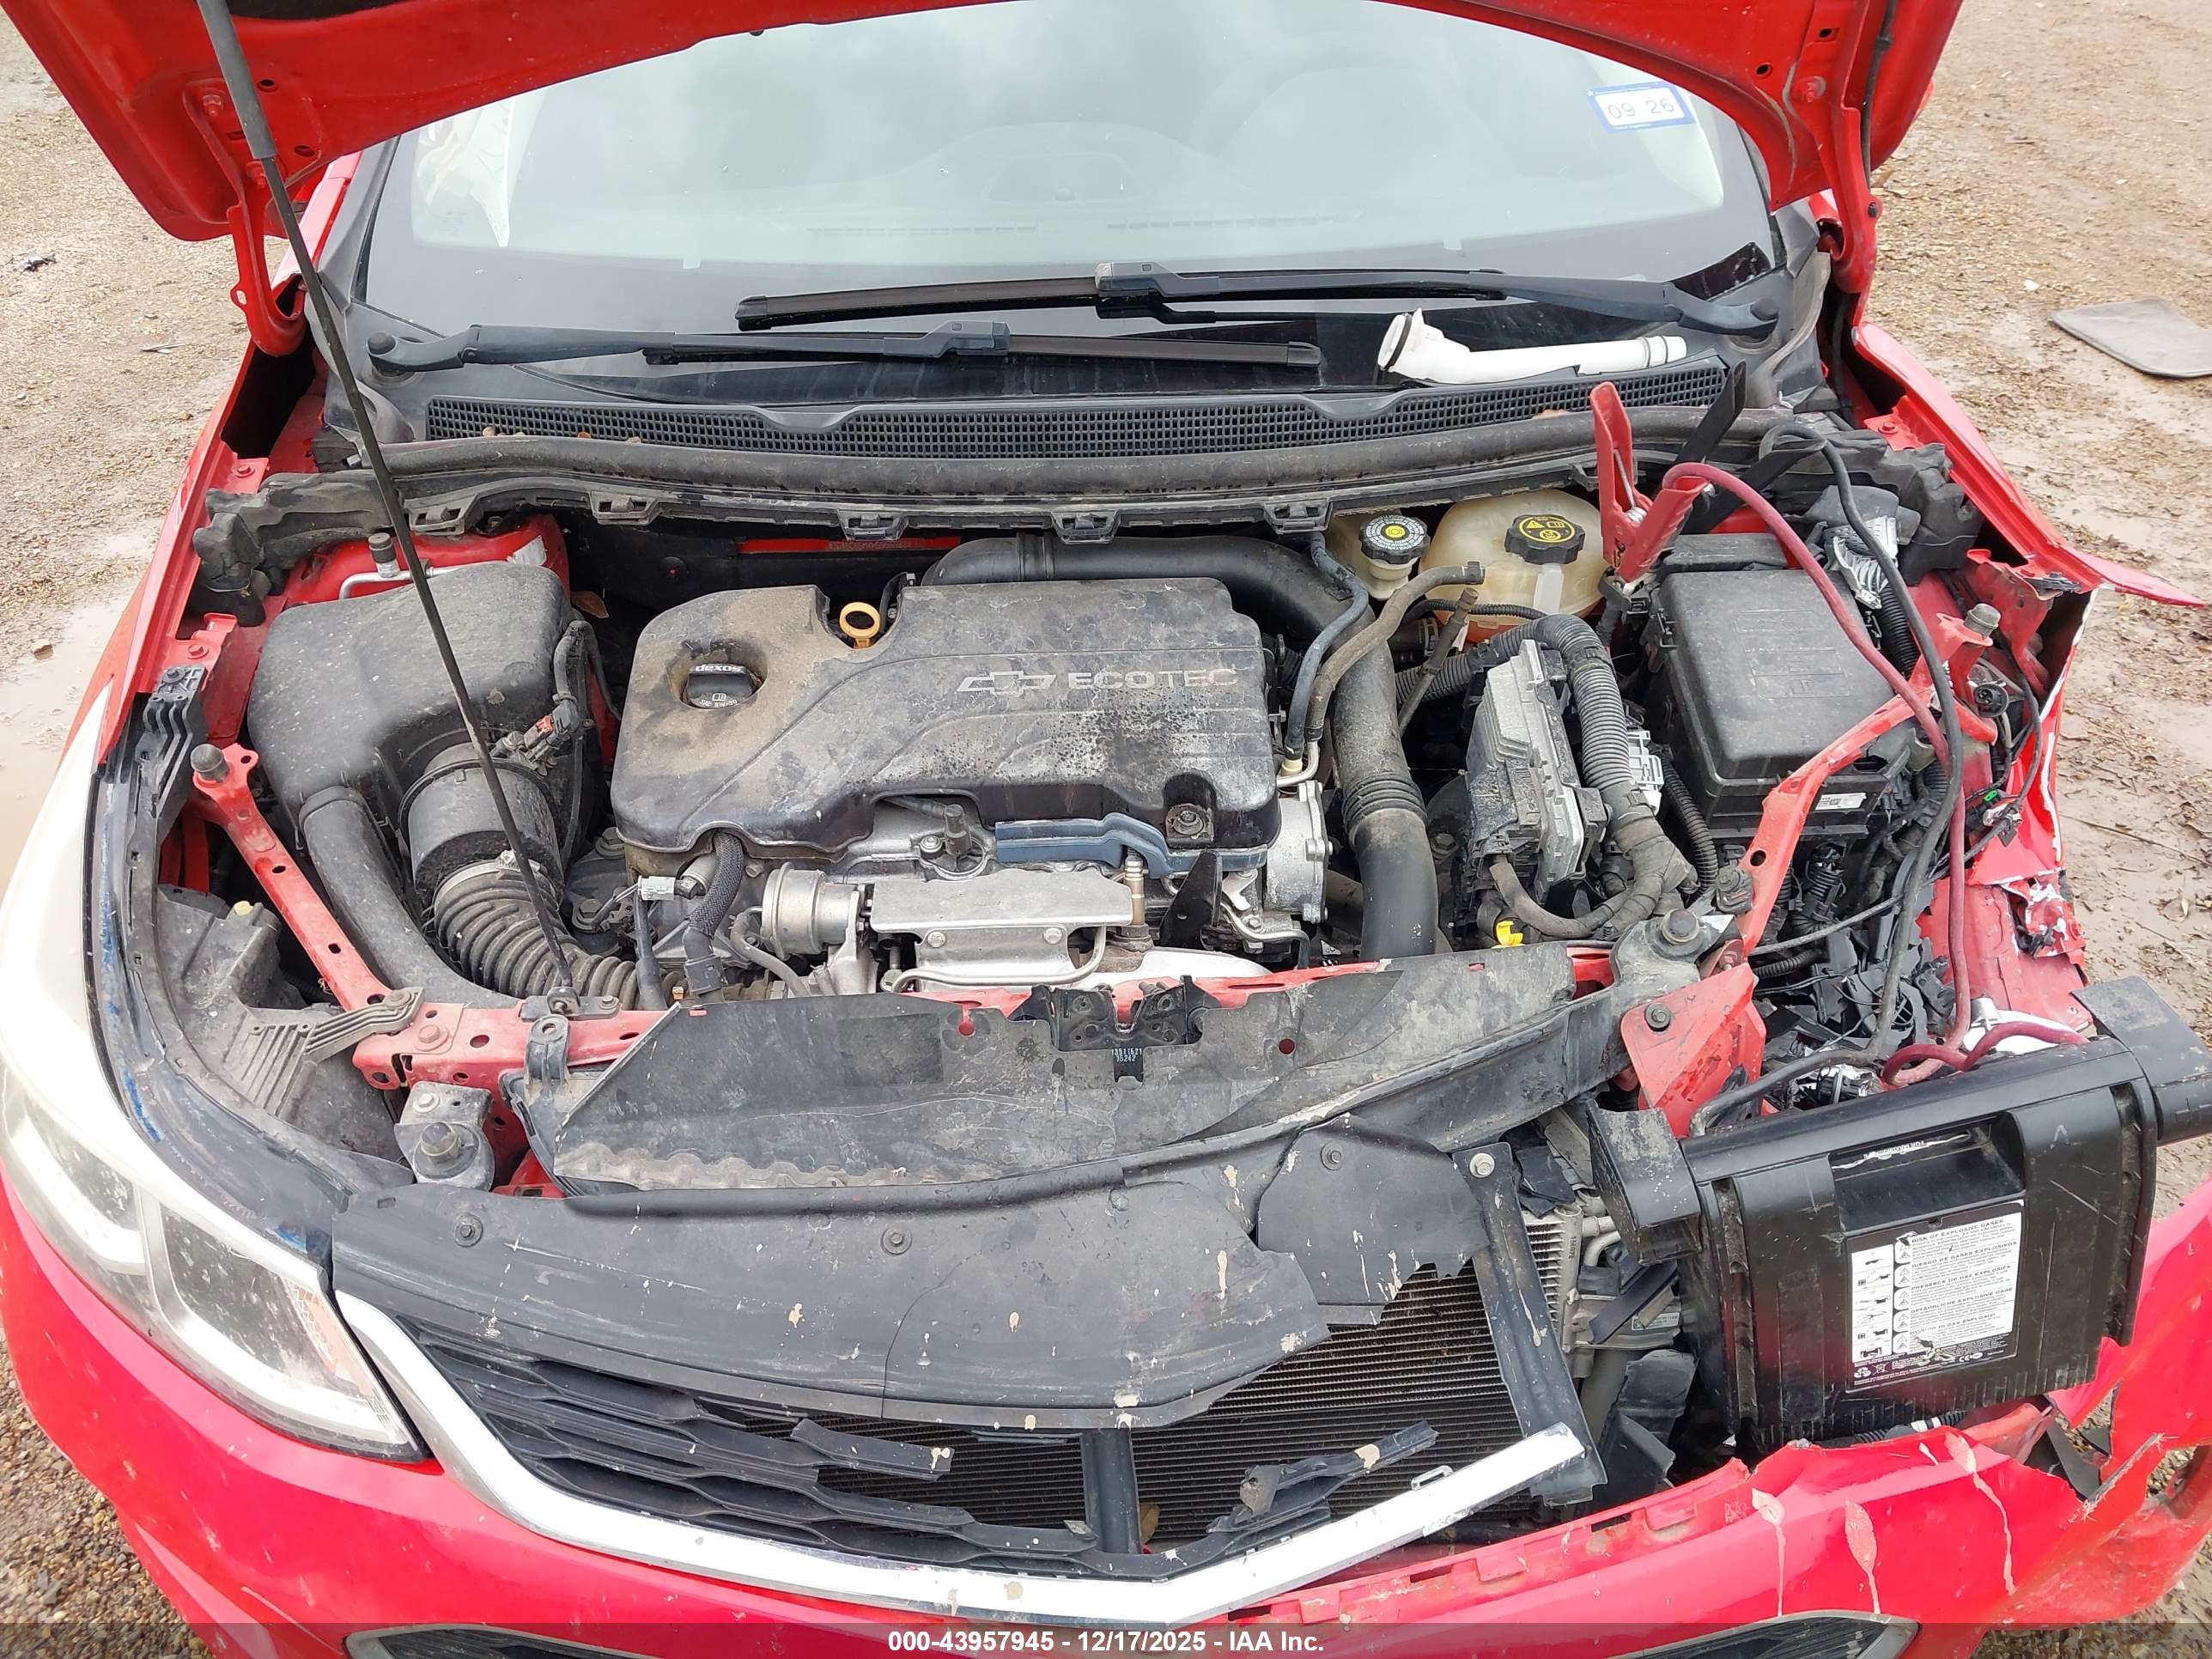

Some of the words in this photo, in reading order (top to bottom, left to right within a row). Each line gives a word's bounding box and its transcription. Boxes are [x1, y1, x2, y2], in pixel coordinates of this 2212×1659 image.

[1607, 102, 1636, 118] 09
[1645, 98, 1675, 114] 26
[695, 664, 743, 672] dexos
[1067, 668, 1238, 690] ECOTEC
[1941, 1224, 1978, 1237] EXPLOSIVE
[1980, 1219, 2004, 1228] GASES
[1974, 1241, 2017, 1255] EXPLOSIVOS
